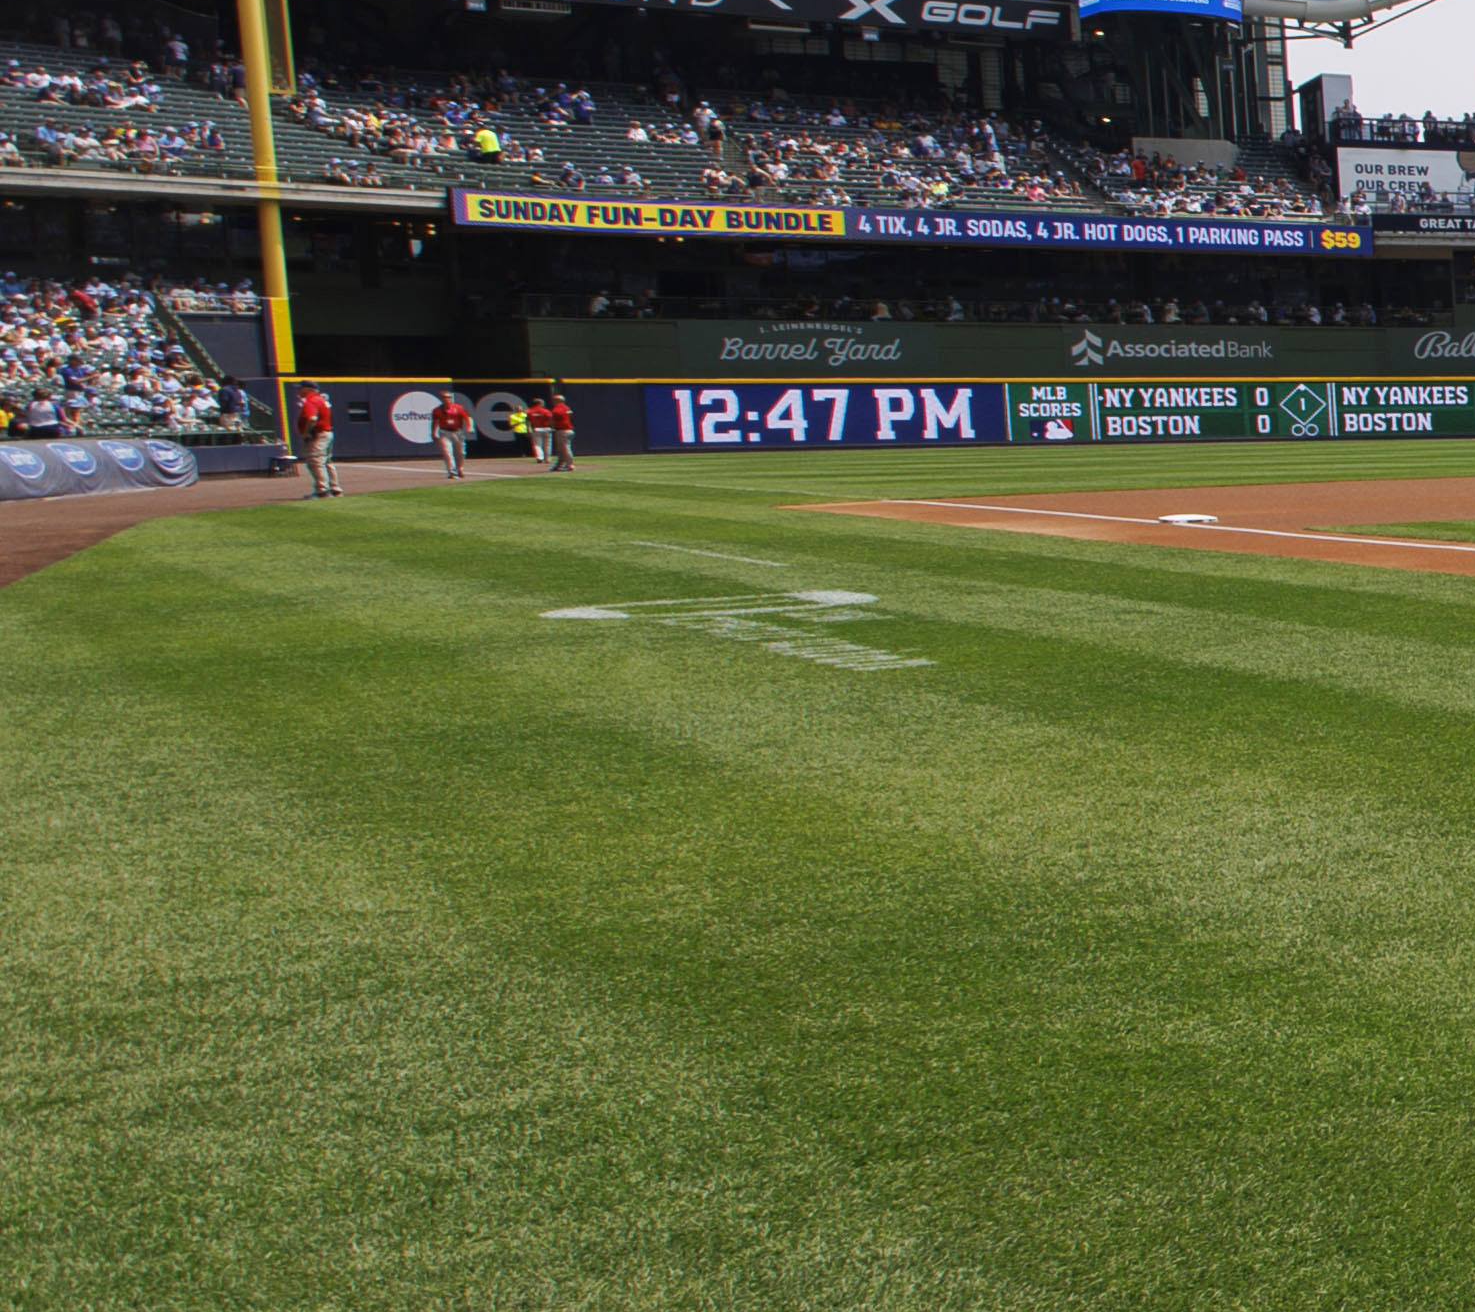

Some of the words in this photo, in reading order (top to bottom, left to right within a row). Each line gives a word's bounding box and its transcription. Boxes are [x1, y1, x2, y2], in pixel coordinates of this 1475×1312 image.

[920, 0, 1061, 31] GOLF
[1355, 164, 1384, 176] OUR
[1388, 164, 1430, 177] BREW
[479, 198, 579, 223] SUNDAY
[725, 210, 834, 233] BUNDLE
[858, 215, 872, 234] 4
[876, 215, 913, 237] TIX,
[916, 217, 930, 236] 4
[967, 220, 1033, 242] SODAS,
[1036, 221, 1050, 240] 4
[1084, 224, 1119, 242] HOT
[1122, 225, 1173, 245] DOGS,
[1189, 228, 1260, 247] PARKING
[1264, 230, 1303, 248] PASS
[1321, 229, 1362, 250] $59
[1419, 218, 1464, 230] GREAT
[719, 336, 819, 361] Barrel
[823, 337, 902, 367] Yard
[1031, 386, 1067, 400] MLB
[1103, 388, 1135, 409] NY
[1138, 387, 1238, 408] YANKEES
[1254, 387, 1270, 407] 0
[1341, 386, 1371, 406] NY
[1373, 385, 1469, 406] YANKEES
[671, 388, 849, 444] 12:47
[873, 388, 976, 441] PM
[1018, 402, 1082, 418] SCORES
[1106, 415, 1201, 437] BOSTON
[1256, 414, 1271, 434] 0
[1343, 412, 1433, 433] BOSTON
